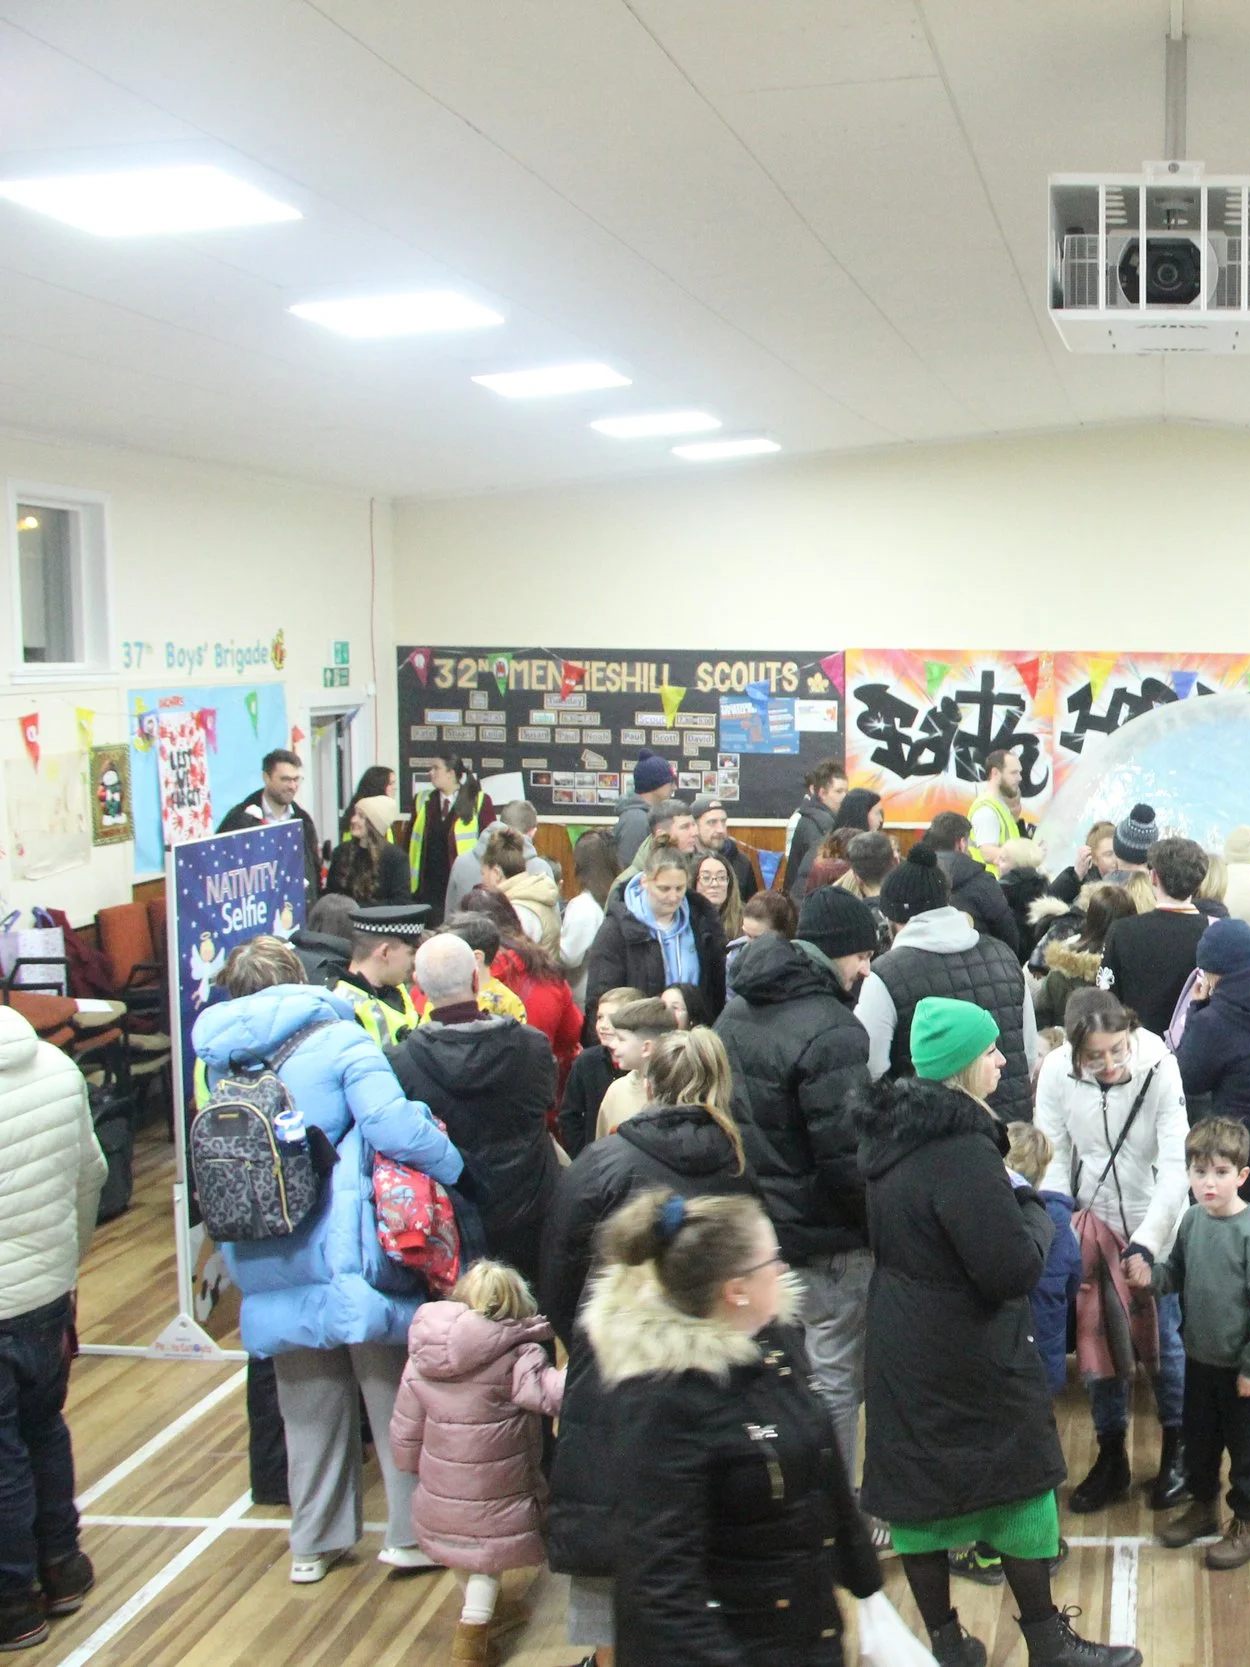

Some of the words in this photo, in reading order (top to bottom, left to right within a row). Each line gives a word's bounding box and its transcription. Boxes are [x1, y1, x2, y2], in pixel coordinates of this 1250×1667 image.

[165, 640, 208, 676] Boys'
[214, 639, 268, 675] Brigade
[432, 657, 492, 689] 32N
[696, 661, 799, 693] SCOUTS
[206, 860, 278, 905] NATIVITY
[222, 895, 267, 934] Selfie
